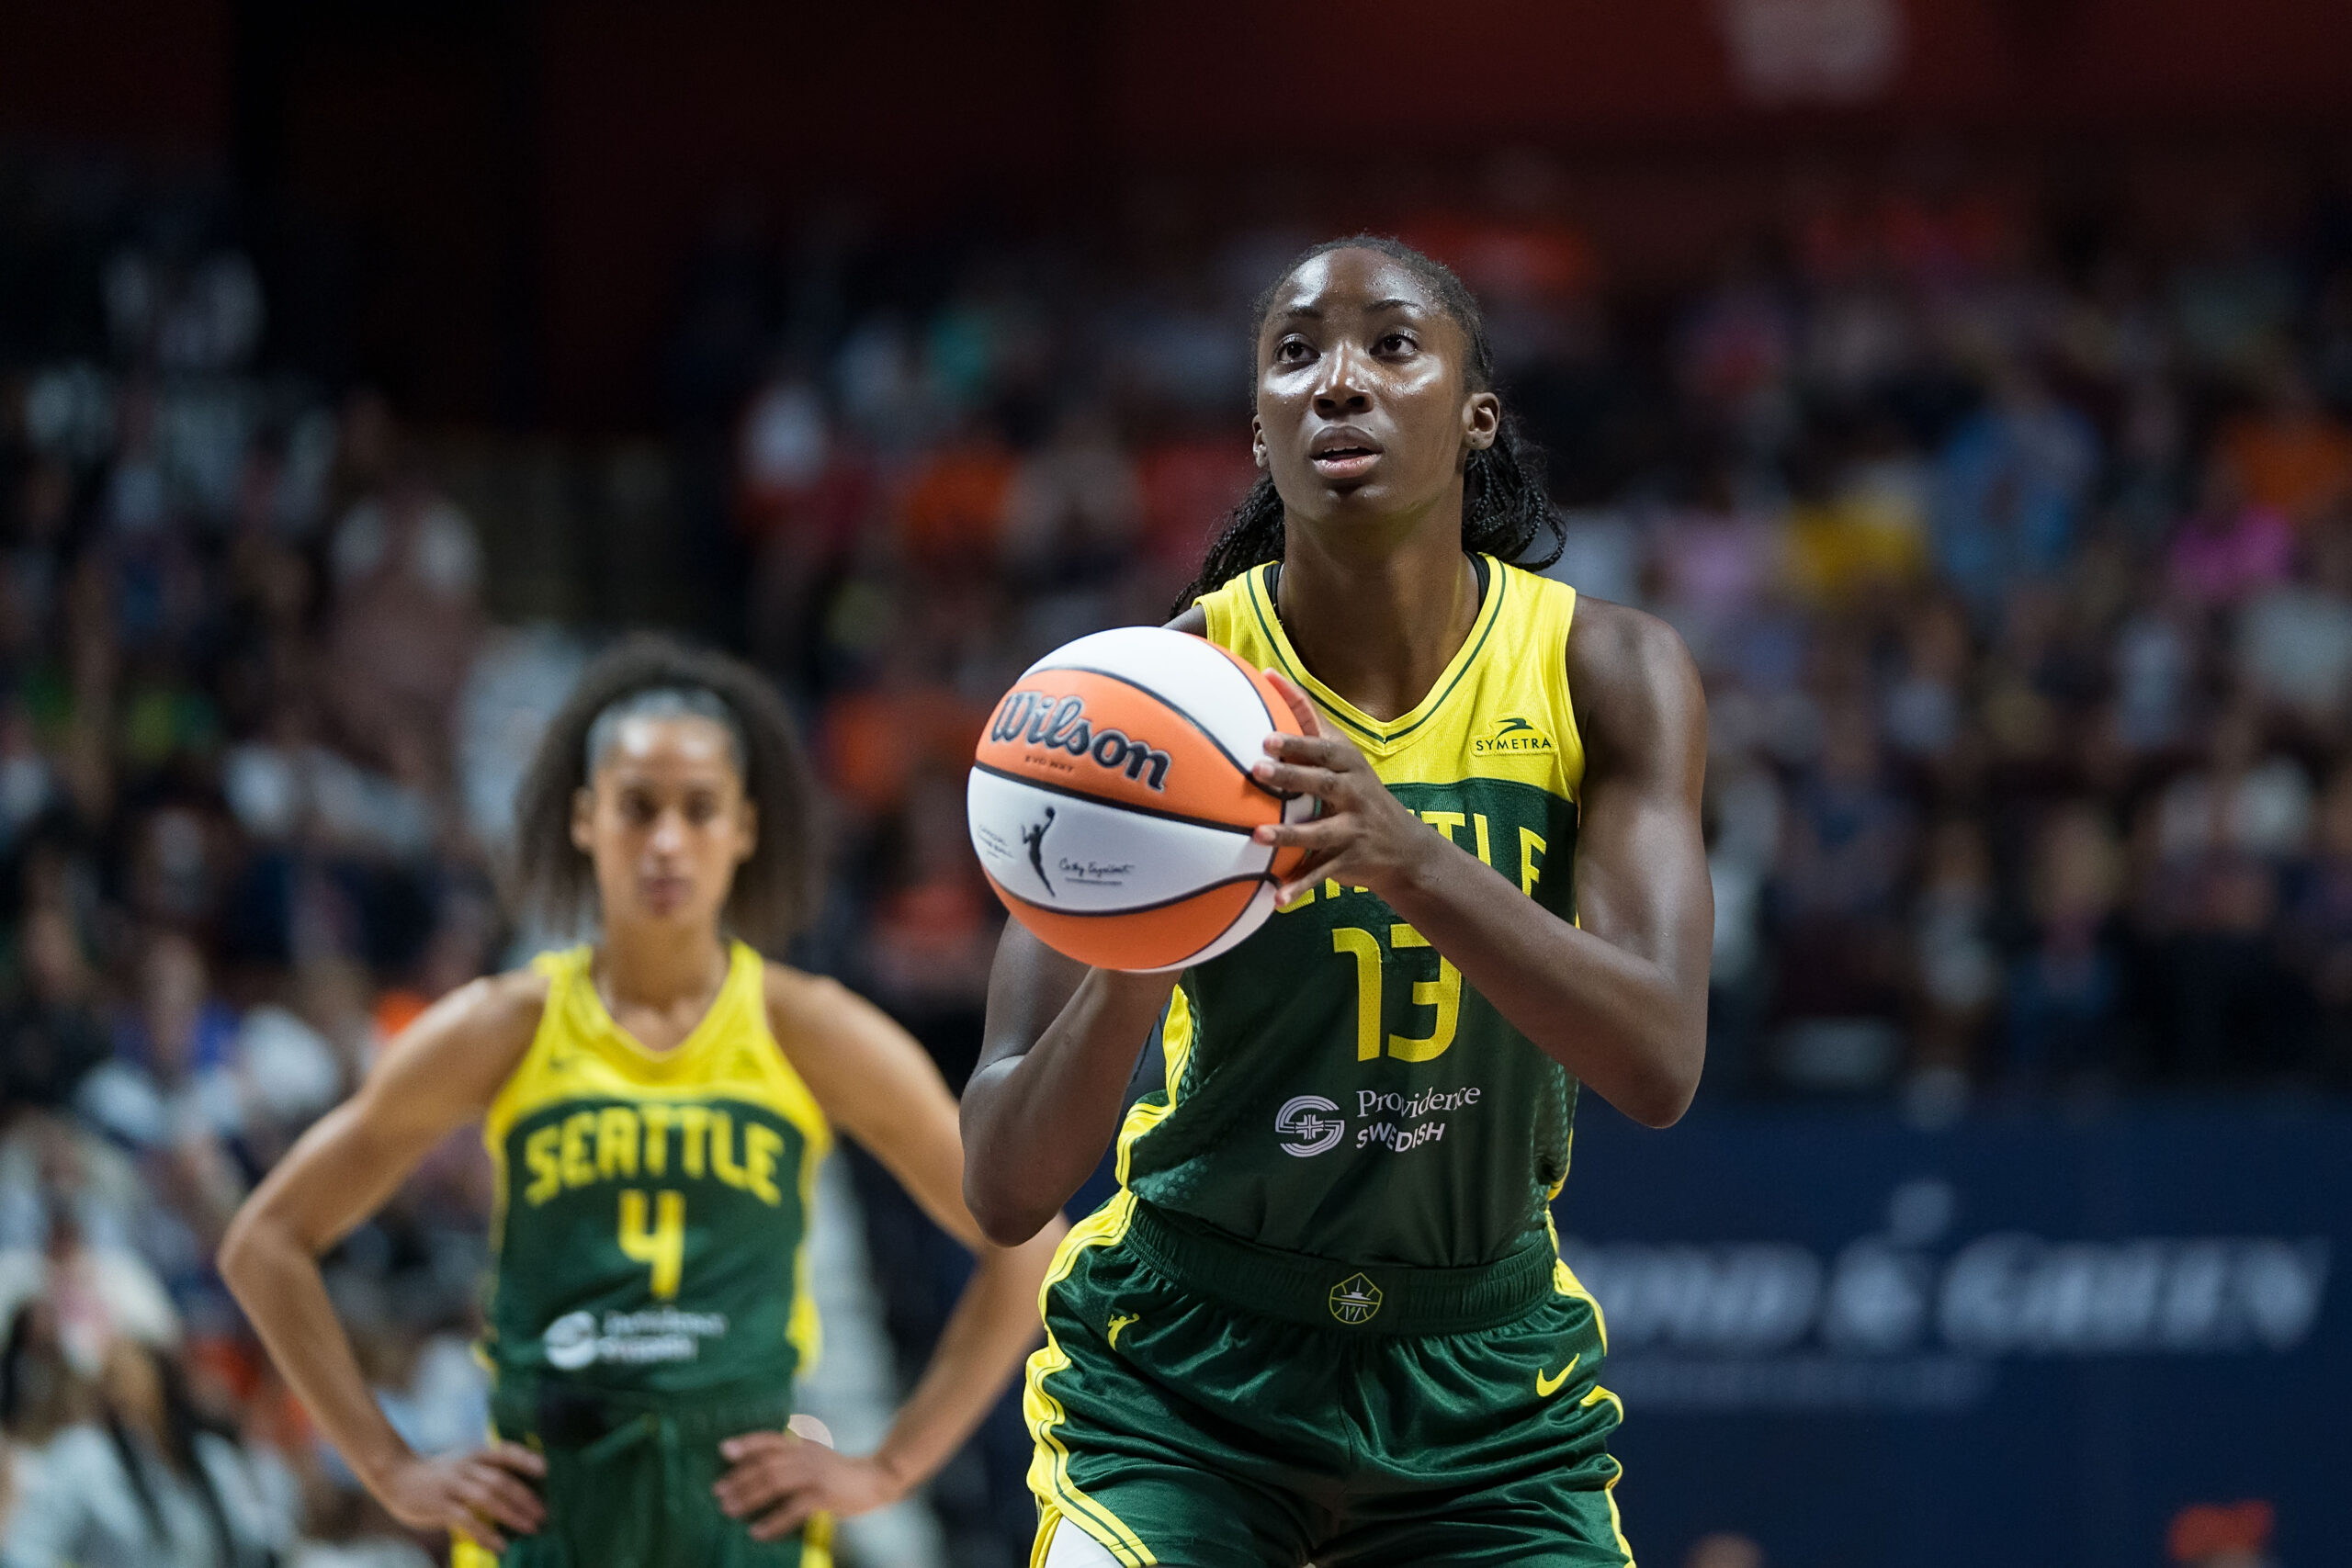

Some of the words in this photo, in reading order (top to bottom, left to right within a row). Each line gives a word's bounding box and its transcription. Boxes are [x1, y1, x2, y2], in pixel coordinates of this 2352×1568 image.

[990, 691, 1173, 793] Wilson
[1476, 738, 1552, 750] SYMETRA
[1331, 923, 1462, 1062] 13
[1356, 1087, 1481, 1118] Providence
[1356, 1122, 1445, 1153] SWEDISH
[525, 1103, 785, 1208] SEATTLE
[618, 1189, 685, 1300] 4
